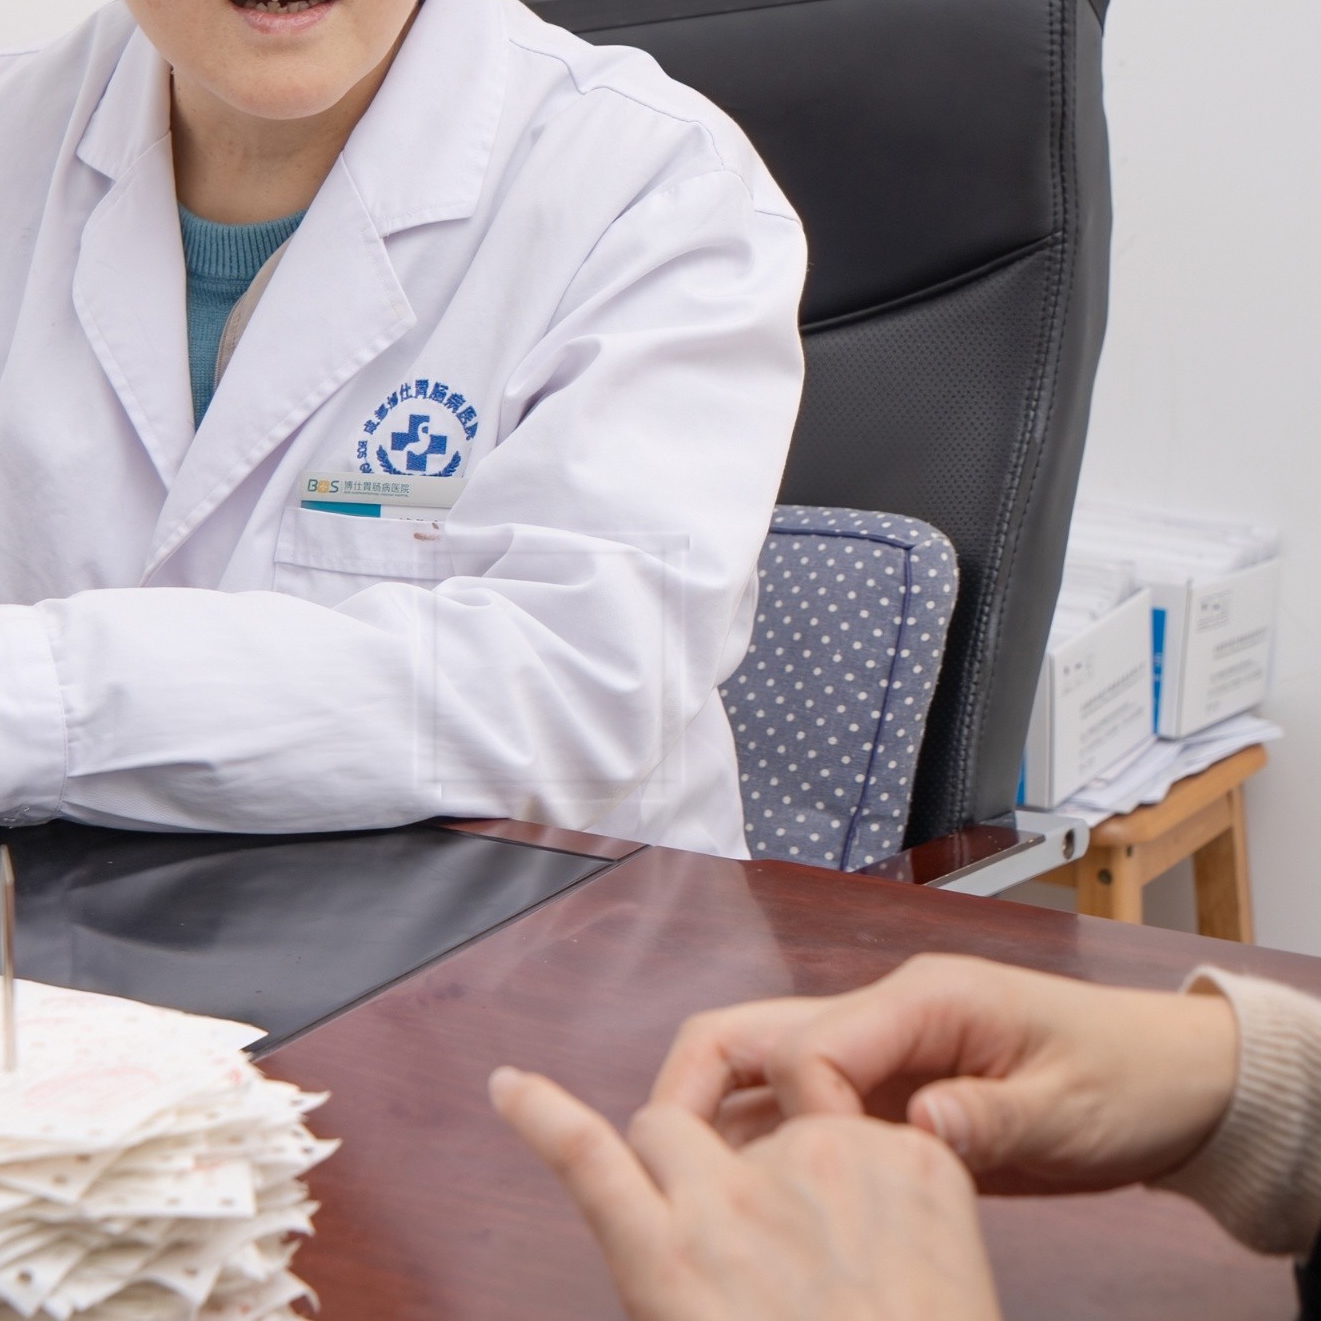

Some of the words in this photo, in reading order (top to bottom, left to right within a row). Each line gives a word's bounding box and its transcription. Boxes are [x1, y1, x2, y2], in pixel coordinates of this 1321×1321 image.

[344, 480, 410, 494] 博仕胃肠病医院
